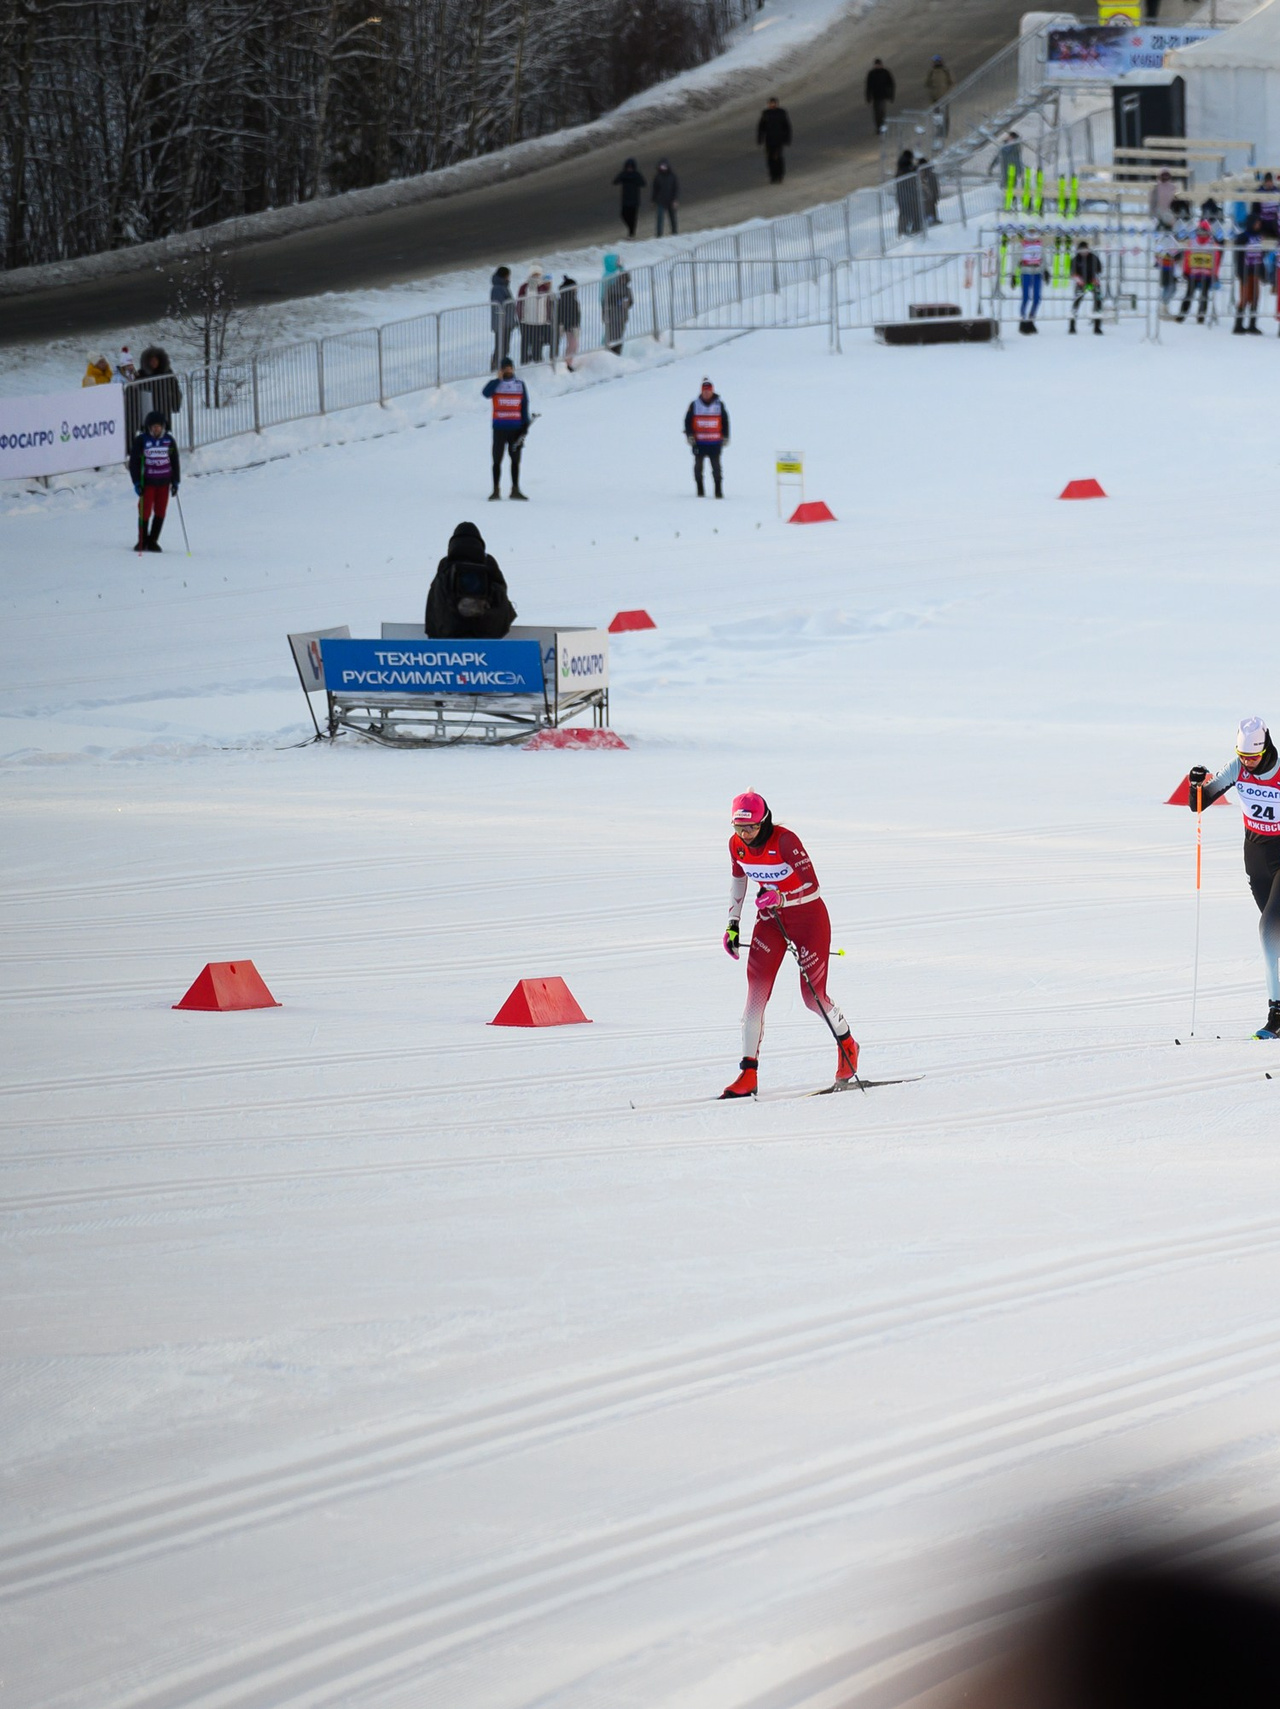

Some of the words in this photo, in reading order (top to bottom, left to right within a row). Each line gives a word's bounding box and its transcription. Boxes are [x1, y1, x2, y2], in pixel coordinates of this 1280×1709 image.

[73, 420, 116, 440] ФОСАГРО
[0, 430, 54, 450] ФОСАГРО
[374, 652, 488, 666] ТЕХНОПАРК
[570, 653, 604, 677] ФОСАГРО
[342, 670, 454, 685] РУСКЛИМАТ
[1251, 803, 1276, 821] 24
[746, 868, 789, 879] ФОСАГРО
